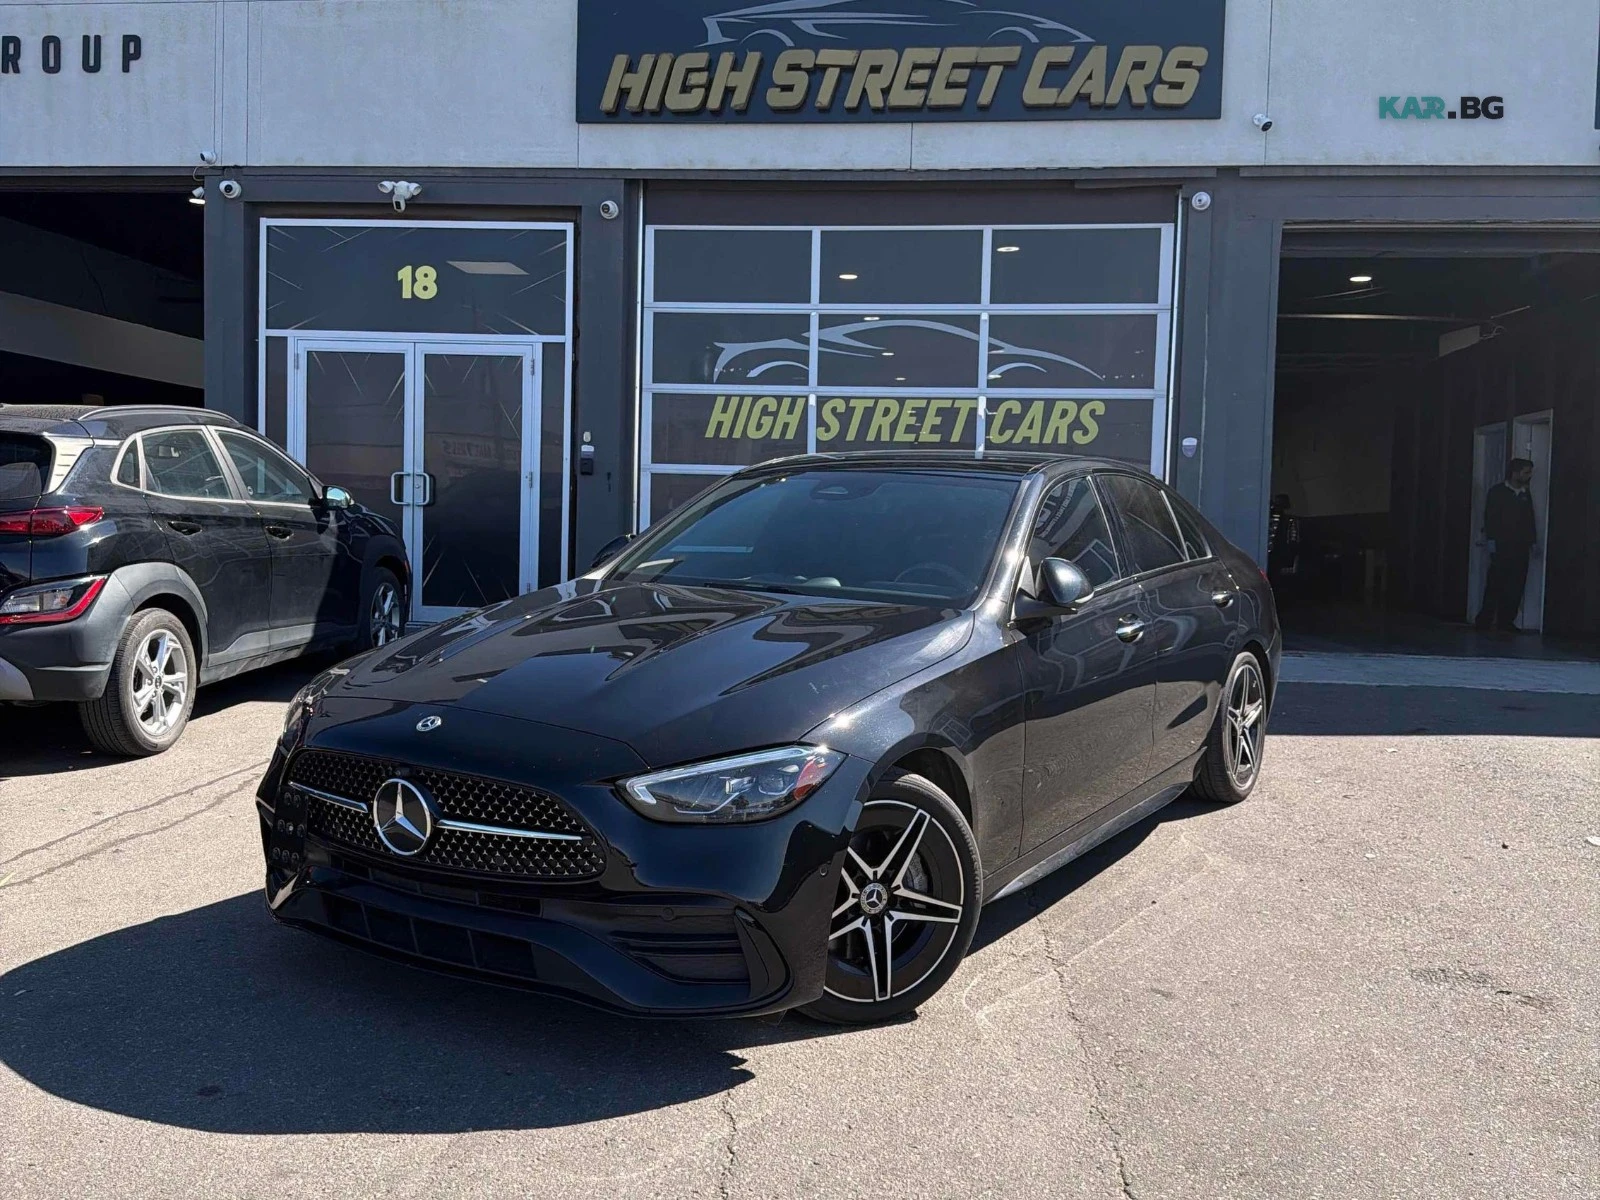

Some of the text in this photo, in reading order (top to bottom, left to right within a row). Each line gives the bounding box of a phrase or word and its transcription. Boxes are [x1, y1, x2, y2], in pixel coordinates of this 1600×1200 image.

[1, 34, 142, 74] ROUP
[600, 45, 1208, 113] HIGH STREET CARS
[397, 265, 438, 300] 18
[705, 396, 1106, 445] HIGH STREET CARS
